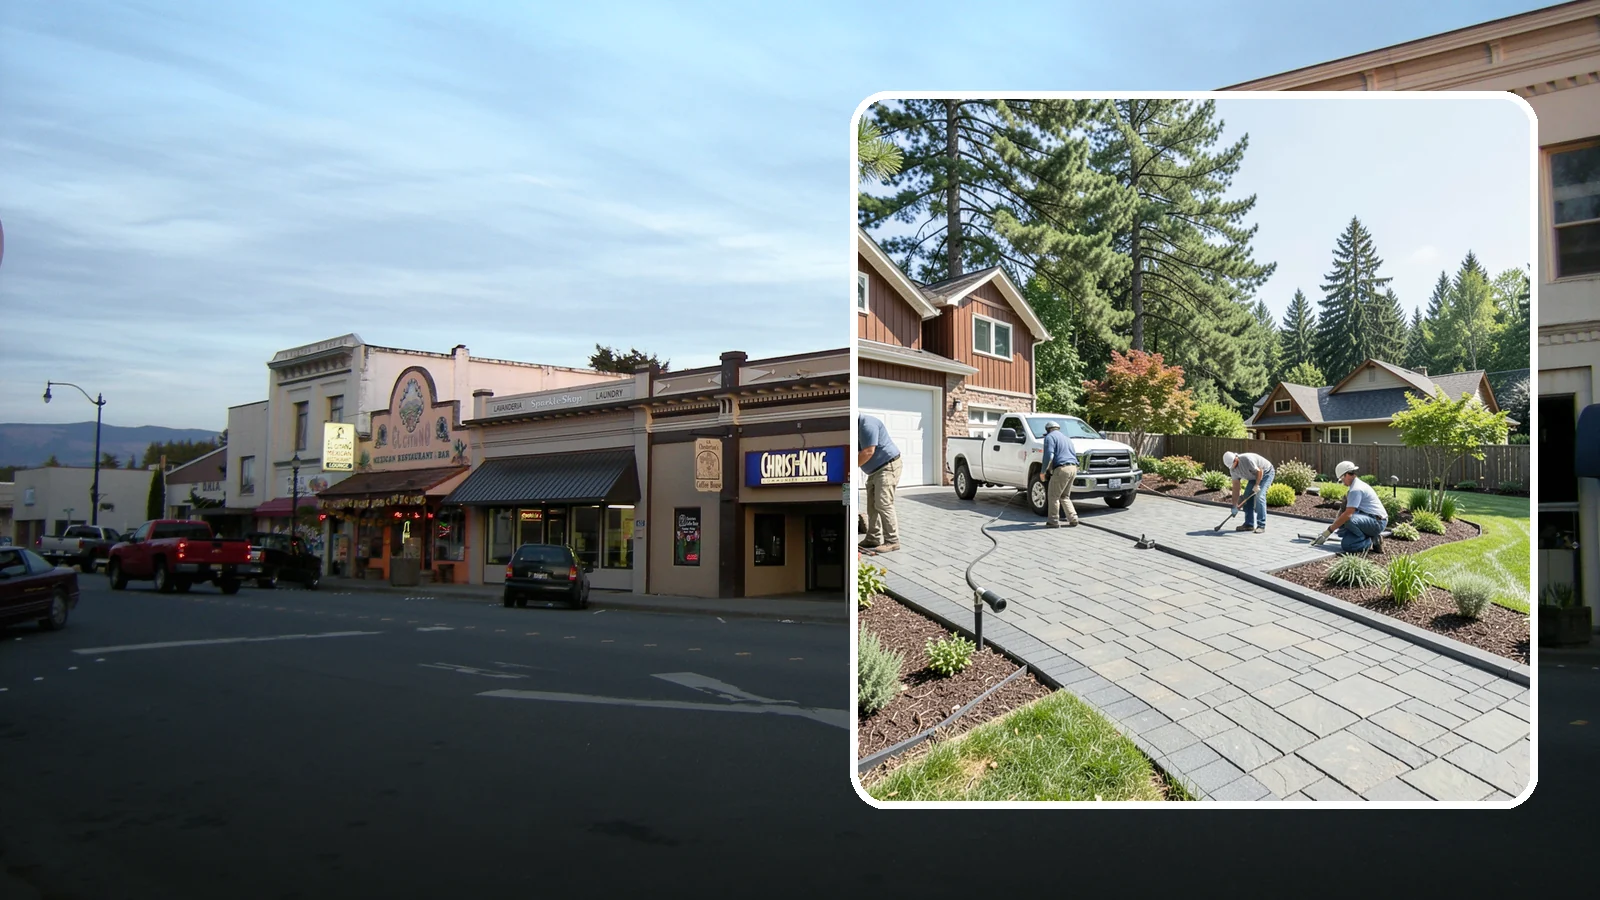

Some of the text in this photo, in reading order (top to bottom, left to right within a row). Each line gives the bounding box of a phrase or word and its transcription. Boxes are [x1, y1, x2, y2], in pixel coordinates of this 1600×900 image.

[494, 389, 623, 413] LAVANDERIA Sparkle Shop LAUNDRY
[374, 455, 396, 464] MEXICAN
[398, 452, 433, 462] RESTAURANT
[438, 450, 450, 459] BAR
[761, 450, 827, 478] CHRIST KING
